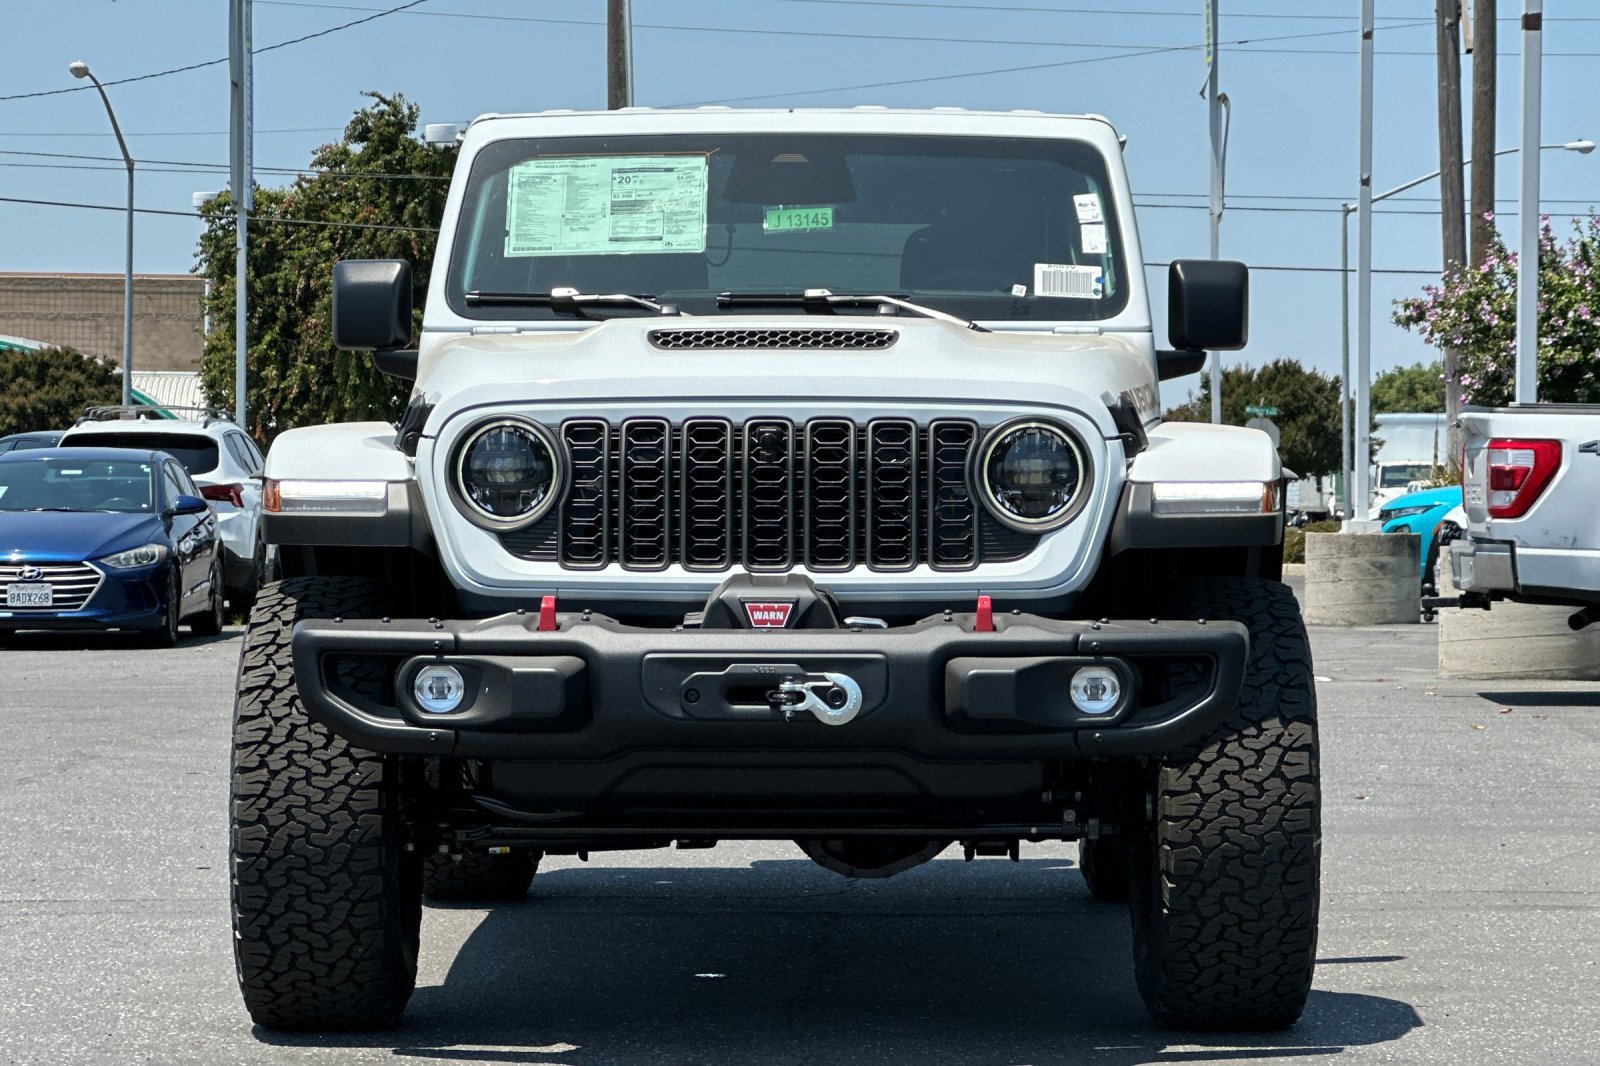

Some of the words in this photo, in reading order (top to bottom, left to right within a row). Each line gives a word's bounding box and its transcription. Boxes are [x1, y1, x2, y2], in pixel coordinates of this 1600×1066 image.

[617, 175, 632, 184] 20
[773, 214, 781, 228] J
[786, 212, 829, 228] 13145
[9, 592, 50, 604] 8ADX268
[753, 611, 784, 620] WARN
